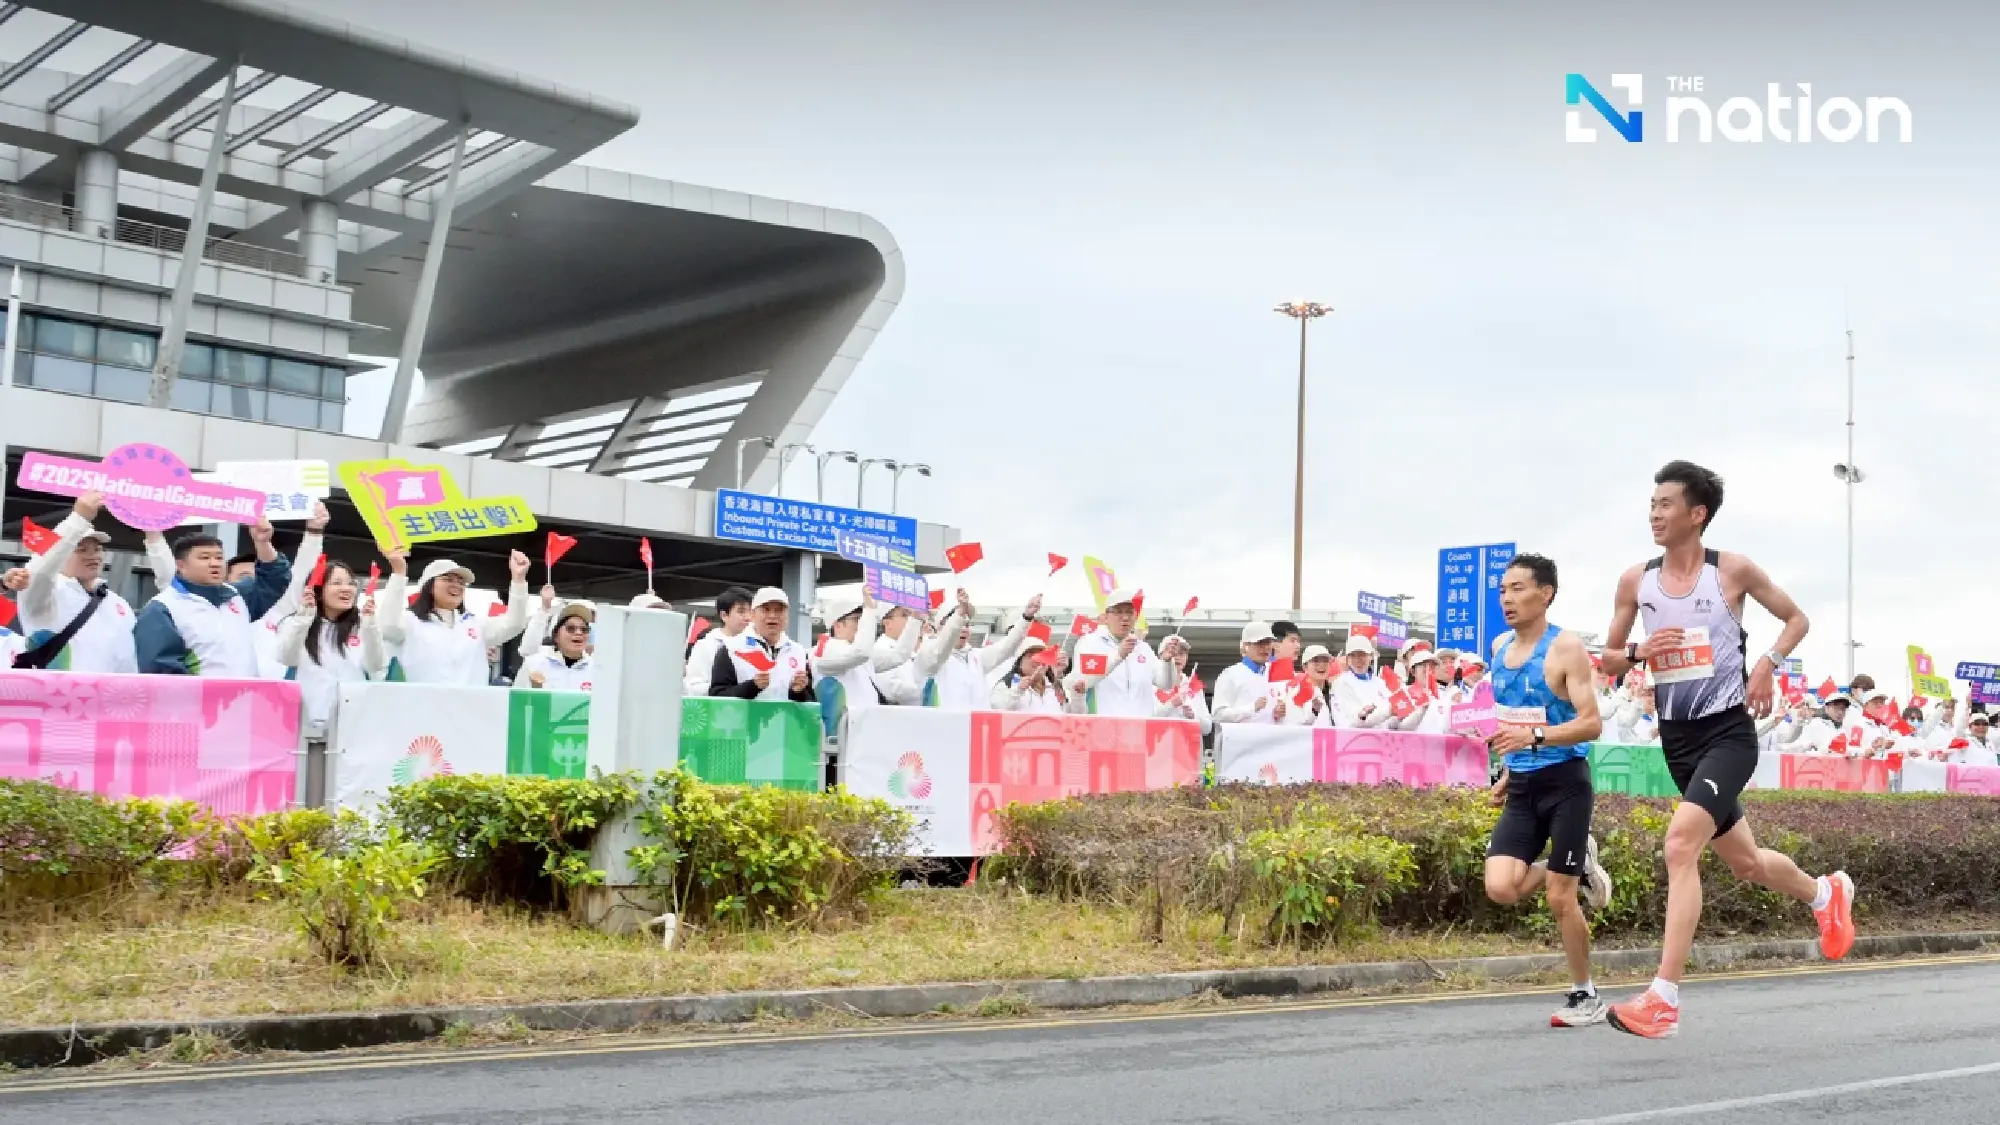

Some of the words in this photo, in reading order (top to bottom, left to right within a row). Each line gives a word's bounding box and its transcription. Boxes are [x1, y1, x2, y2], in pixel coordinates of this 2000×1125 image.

[28, 461, 258, 518] #2025NationalGamesHK
[724, 511, 764, 526] Inbound
[765, 516, 801, 530] Private
[801, 521, 818, 533] Car
[722, 522, 767, 538] Customs
[768, 528, 776, 540] &
[777, 530, 807, 544] Excise
[1447, 551, 1473, 562] Coach
[1490, 548, 1512, 560] Hong
[1444, 564, 1460, 574] Pick
[1447, 608, 1470, 623] 巴士
[1440, 626, 1475, 643] 上客區
